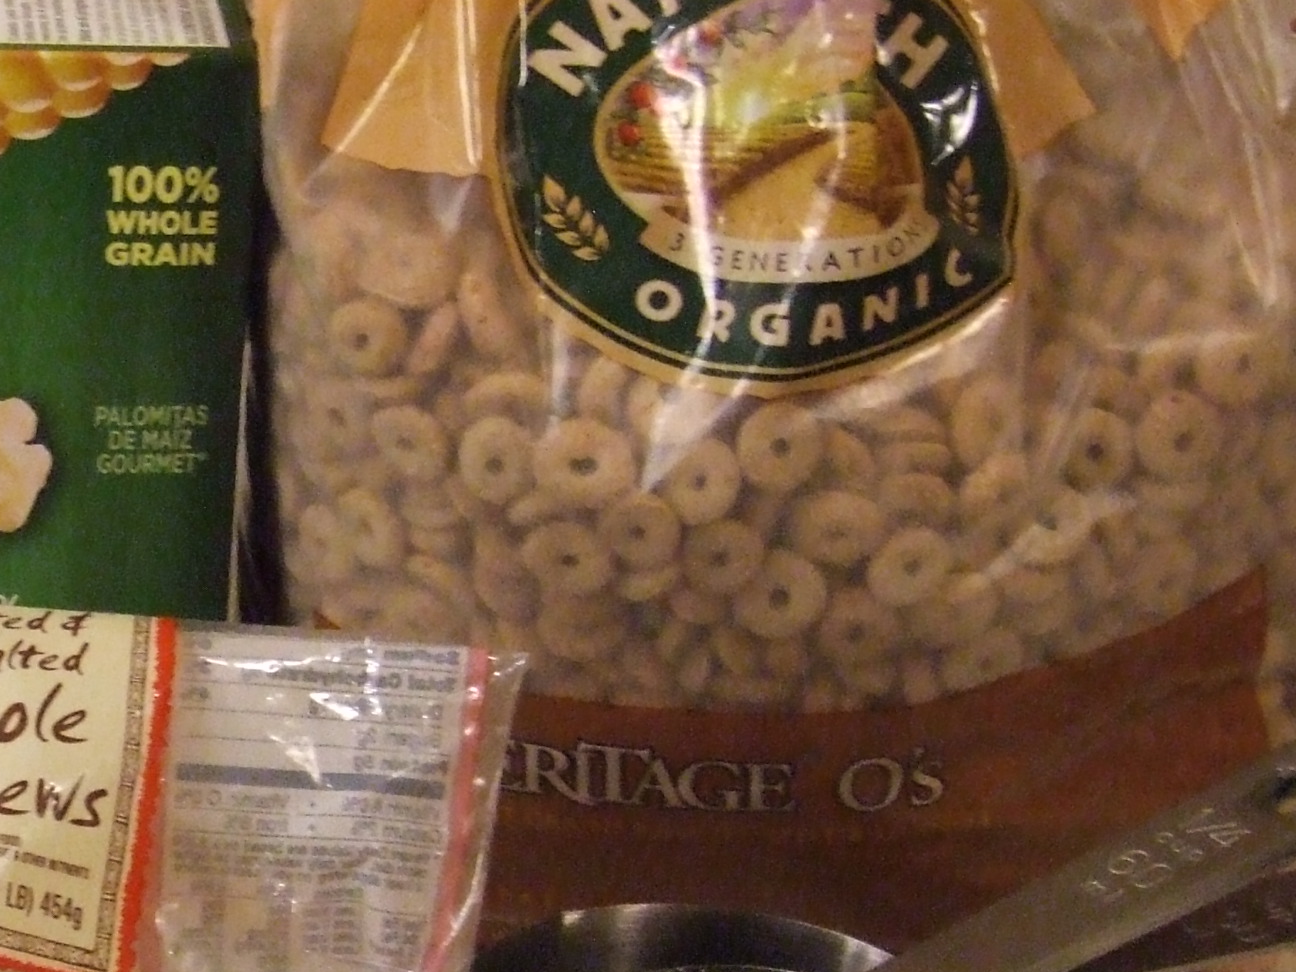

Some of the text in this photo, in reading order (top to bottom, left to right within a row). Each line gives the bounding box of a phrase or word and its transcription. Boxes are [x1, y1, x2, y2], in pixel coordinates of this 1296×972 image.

[528, 0, 681, 97] NA
[107, 165, 220, 204] 100%
[106, 210, 218, 235] WHOLE
[105, 242, 216, 266] GRAIN
[634, 248, 974, 347] ORGANIC
[108, 430, 137, 450] DE
[5, 881, 35, 917] LB)
[39, 891, 83, 931] 454g
